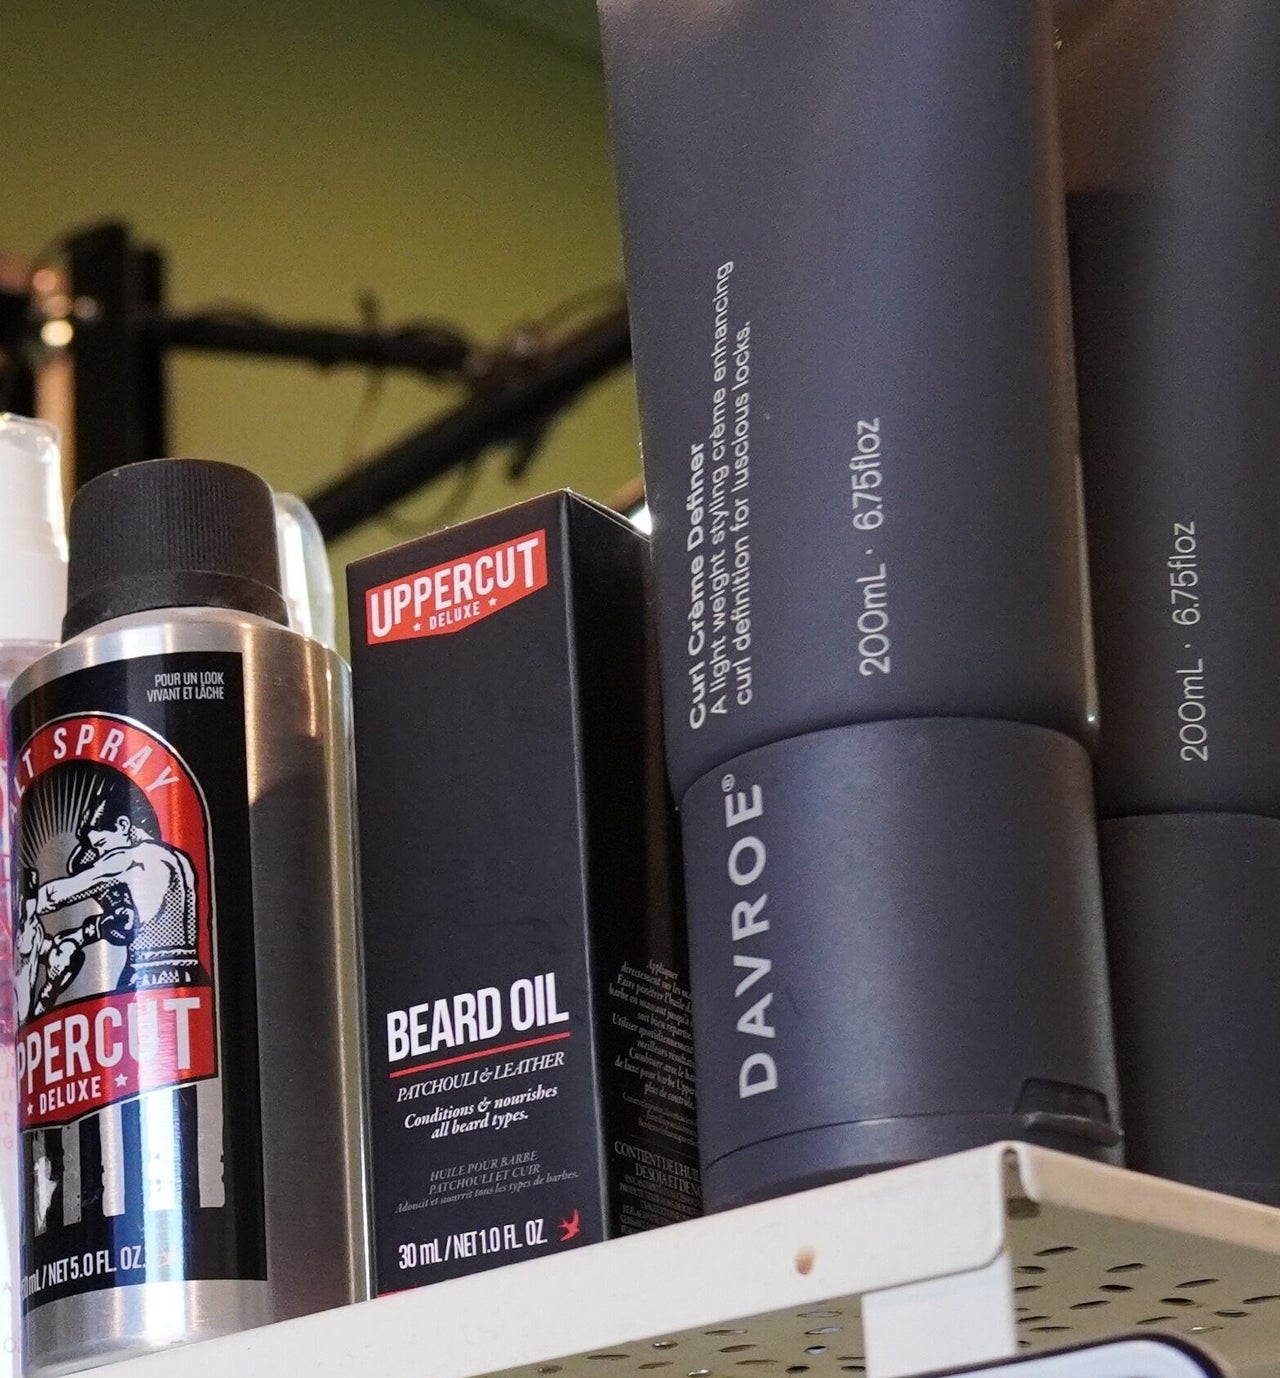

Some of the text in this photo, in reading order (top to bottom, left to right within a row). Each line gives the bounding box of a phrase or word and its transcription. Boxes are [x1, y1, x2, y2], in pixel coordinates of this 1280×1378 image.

[709, 261, 734, 714] A light weight styling crème enhancing
[729, 321, 753, 706] curl definition for luscious locks.
[849, 417, 891, 676] 200mL 6.75floz
[370, 538, 539, 638] UPPERCUT
[686, 442, 707, 730] Curl Crème Definer
[429, 600, 481, 631] DELUXE
[1167, 521, 1209, 762] 200mL 6.75floz
[146, 687, 181, 703] VIVANT
[183, 686, 193, 700] ET
[155, 671, 225, 687] POUR UN LOOK
[9, 724, 180, 820] ALT SPRAY
[386, 972, 570, 1063] BEARD OIL
[16, 997, 201, 1105] PPERCUT
[39, 1076, 102, 1116] DELUXE
[397, 1051, 565, 1102] PATCHOULI & LEATHER
[404, 1083, 559, 1129] Conditions & nourishes
[430, 1109, 529, 1140] all beard types.
[428, 1163, 541, 1196] PATCHOULI ET CUIR
[429, 1150, 539, 1182] HUILE POUR BARBE
[494, 1182, 508, 1194] les
[509, 1179, 531, 1193] types
[533, 1174, 545, 1187] de
[96, 1250, 117, 1274] FL.
[120, 1245, 146, 1271] OZ.
[398, 1242, 417, 1270] 30
[419, 1237, 443, 1266] mL
